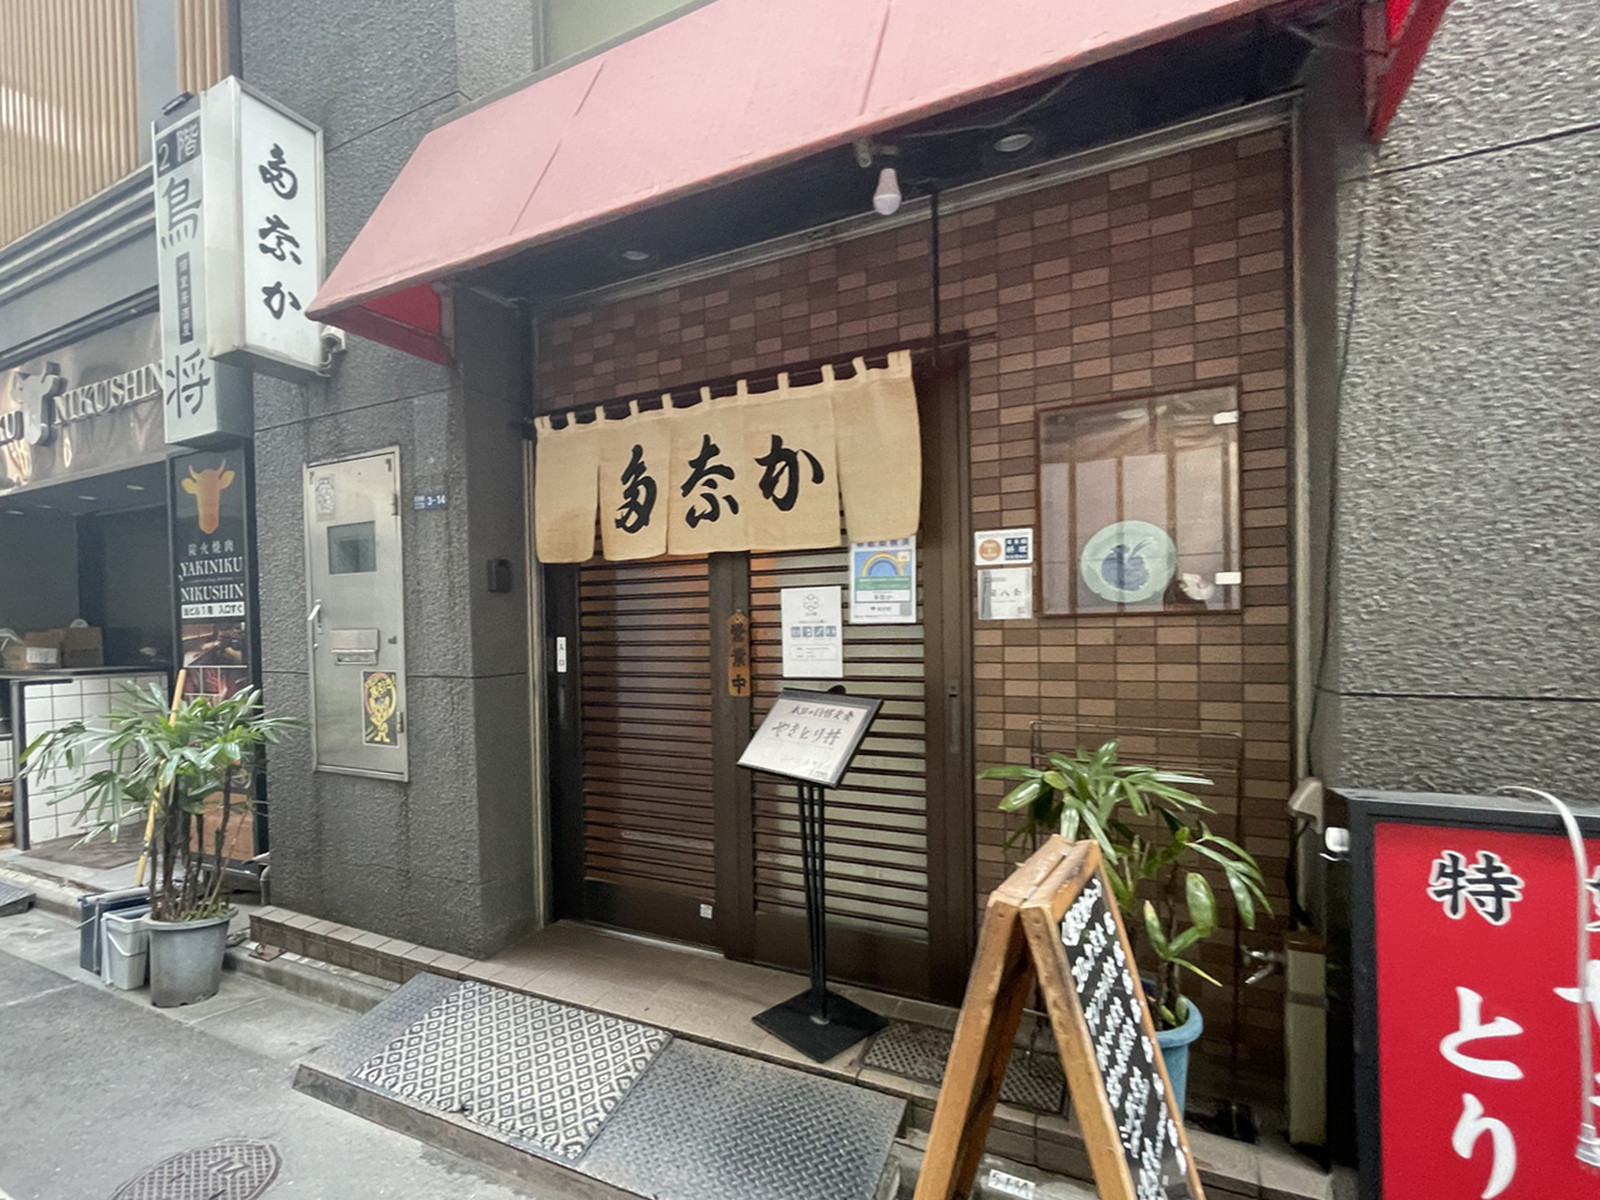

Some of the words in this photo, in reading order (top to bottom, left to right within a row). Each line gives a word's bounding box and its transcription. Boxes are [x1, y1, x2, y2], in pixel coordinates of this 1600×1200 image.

[53, 360, 164, 425] NIKUSHIN
[165, 348, 212, 419] 将
[180, 557, 243, 576] YAKINIKU
[181, 583, 244, 601] NIKUSHIN
